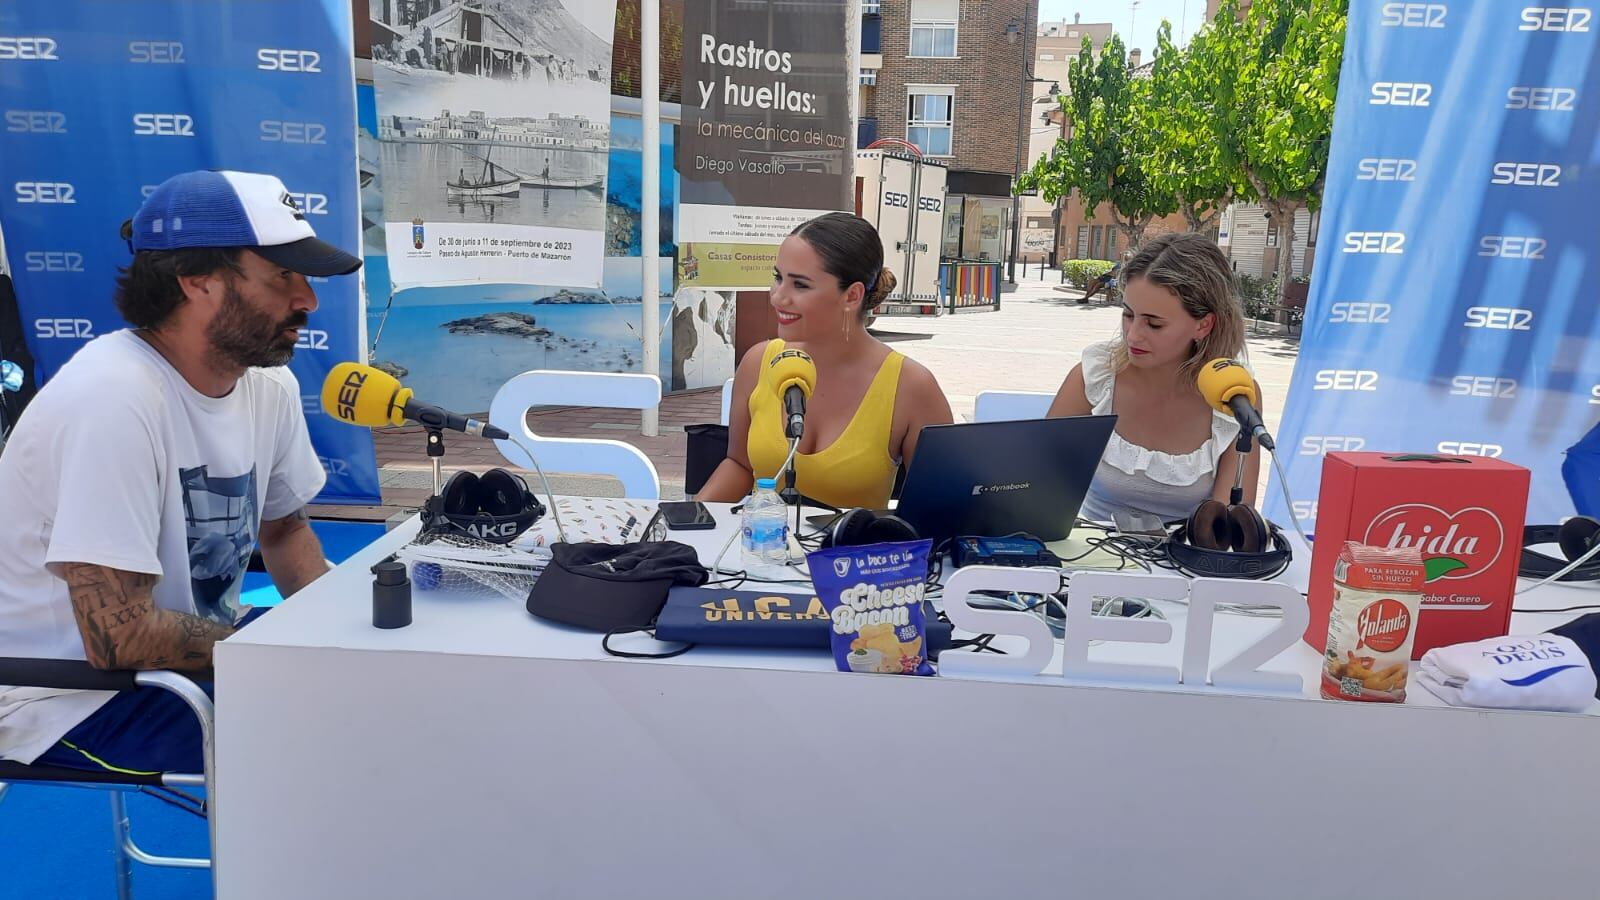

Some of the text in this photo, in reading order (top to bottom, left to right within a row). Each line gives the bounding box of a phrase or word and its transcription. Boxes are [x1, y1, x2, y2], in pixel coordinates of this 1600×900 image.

[1381, 4, 1447, 29] SER
[1518, 8, 1592, 32] SER
[0, 37, 58, 60] SER
[129, 41, 185, 63] SER
[701, 33, 792, 74] Rastros
[257, 49, 321, 73] SER
[698, 76, 816, 114] y huellas:
[1370, 82, 1432, 106] SER
[1505, 87, 1576, 111] SER
[5, 110, 67, 133] SER
[133, 113, 195, 136] SER
[260, 120, 326, 144] SER
[697, 118, 847, 149] la mecánica del azar
[696, 155, 786, 175] Diego Vasallo
[1357, 158, 1417, 181] SER
[1491, 162, 1561, 187] SER
[15, 182, 76, 204] SER
[290, 192, 328, 214] ER
[885, 192, 908, 208] SER
[918, 196, 941, 212] SER
[490, 238, 498, 246] de
[500, 238, 542, 248] septiembre
[543, 241, 553, 249] de
[554, 241, 572, 250] 2023
[508, 250, 529, 258] Puerto
[1343, 231, 1405, 254] SER
[1478, 236, 1547, 259] SER
[25, 251, 84, 272] SER
[708, 251, 777, 262] Casas Consistori
[1329, 303, 1391, 323] SER
[1464, 306, 1533, 330] SER
[35, 318, 94, 338] SER
[294, 329, 329, 350] ER
[1313, 370, 1378, 391] SER
[1450, 375, 1517, 398] SER
[337, 370, 368, 422] SER
[990, 482, 1030, 493] dynabook
[467, 522, 517, 538] AKG
[1386, 522, 1479, 554] hida
[1386, 575, 1412, 583] HUEVO
[840, 582, 925, 612] Cheese
[1449, 593, 1481, 603] Casero
[831, 605, 909, 634] Bacon
[938, 565, 1311, 692] SER
[1359, 604, 1408, 643] Yolanda
[1482, 639, 1554, 657] AQUA
[1493, 646, 1566, 665] DEUS
